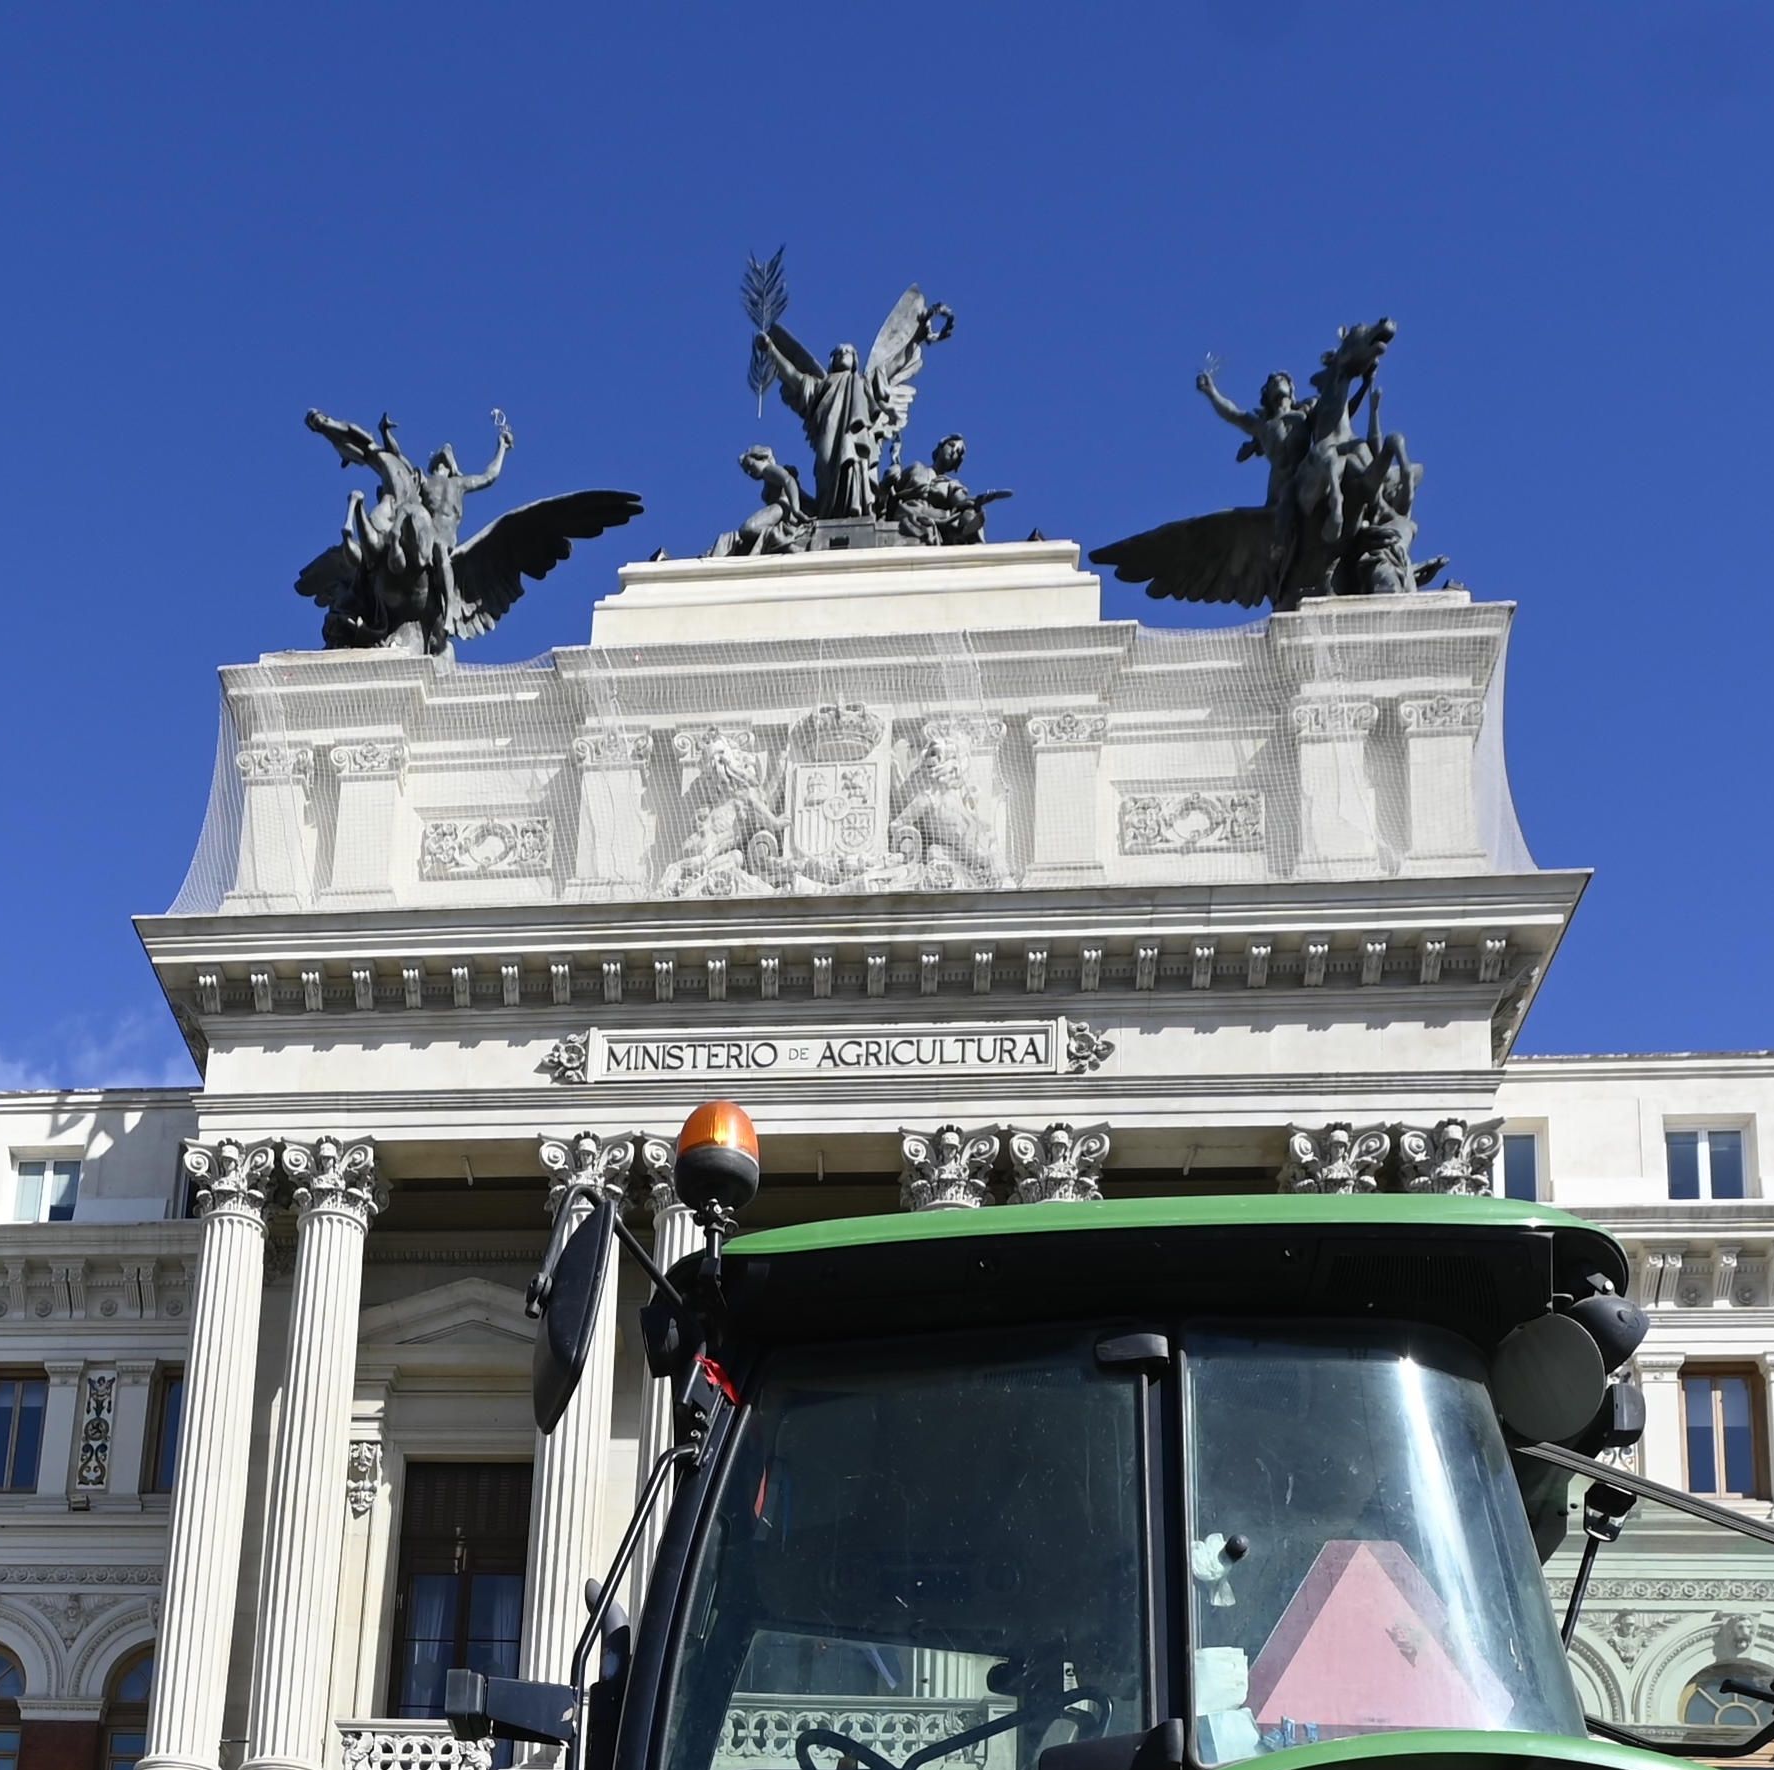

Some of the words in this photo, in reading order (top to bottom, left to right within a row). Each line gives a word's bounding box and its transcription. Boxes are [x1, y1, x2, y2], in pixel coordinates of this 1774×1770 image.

[605, 1042, 778, 1072] MINISTERIO
[788, 1046, 810, 1062] DE
[816, 1036, 1049, 1069] AGRICULTURA
